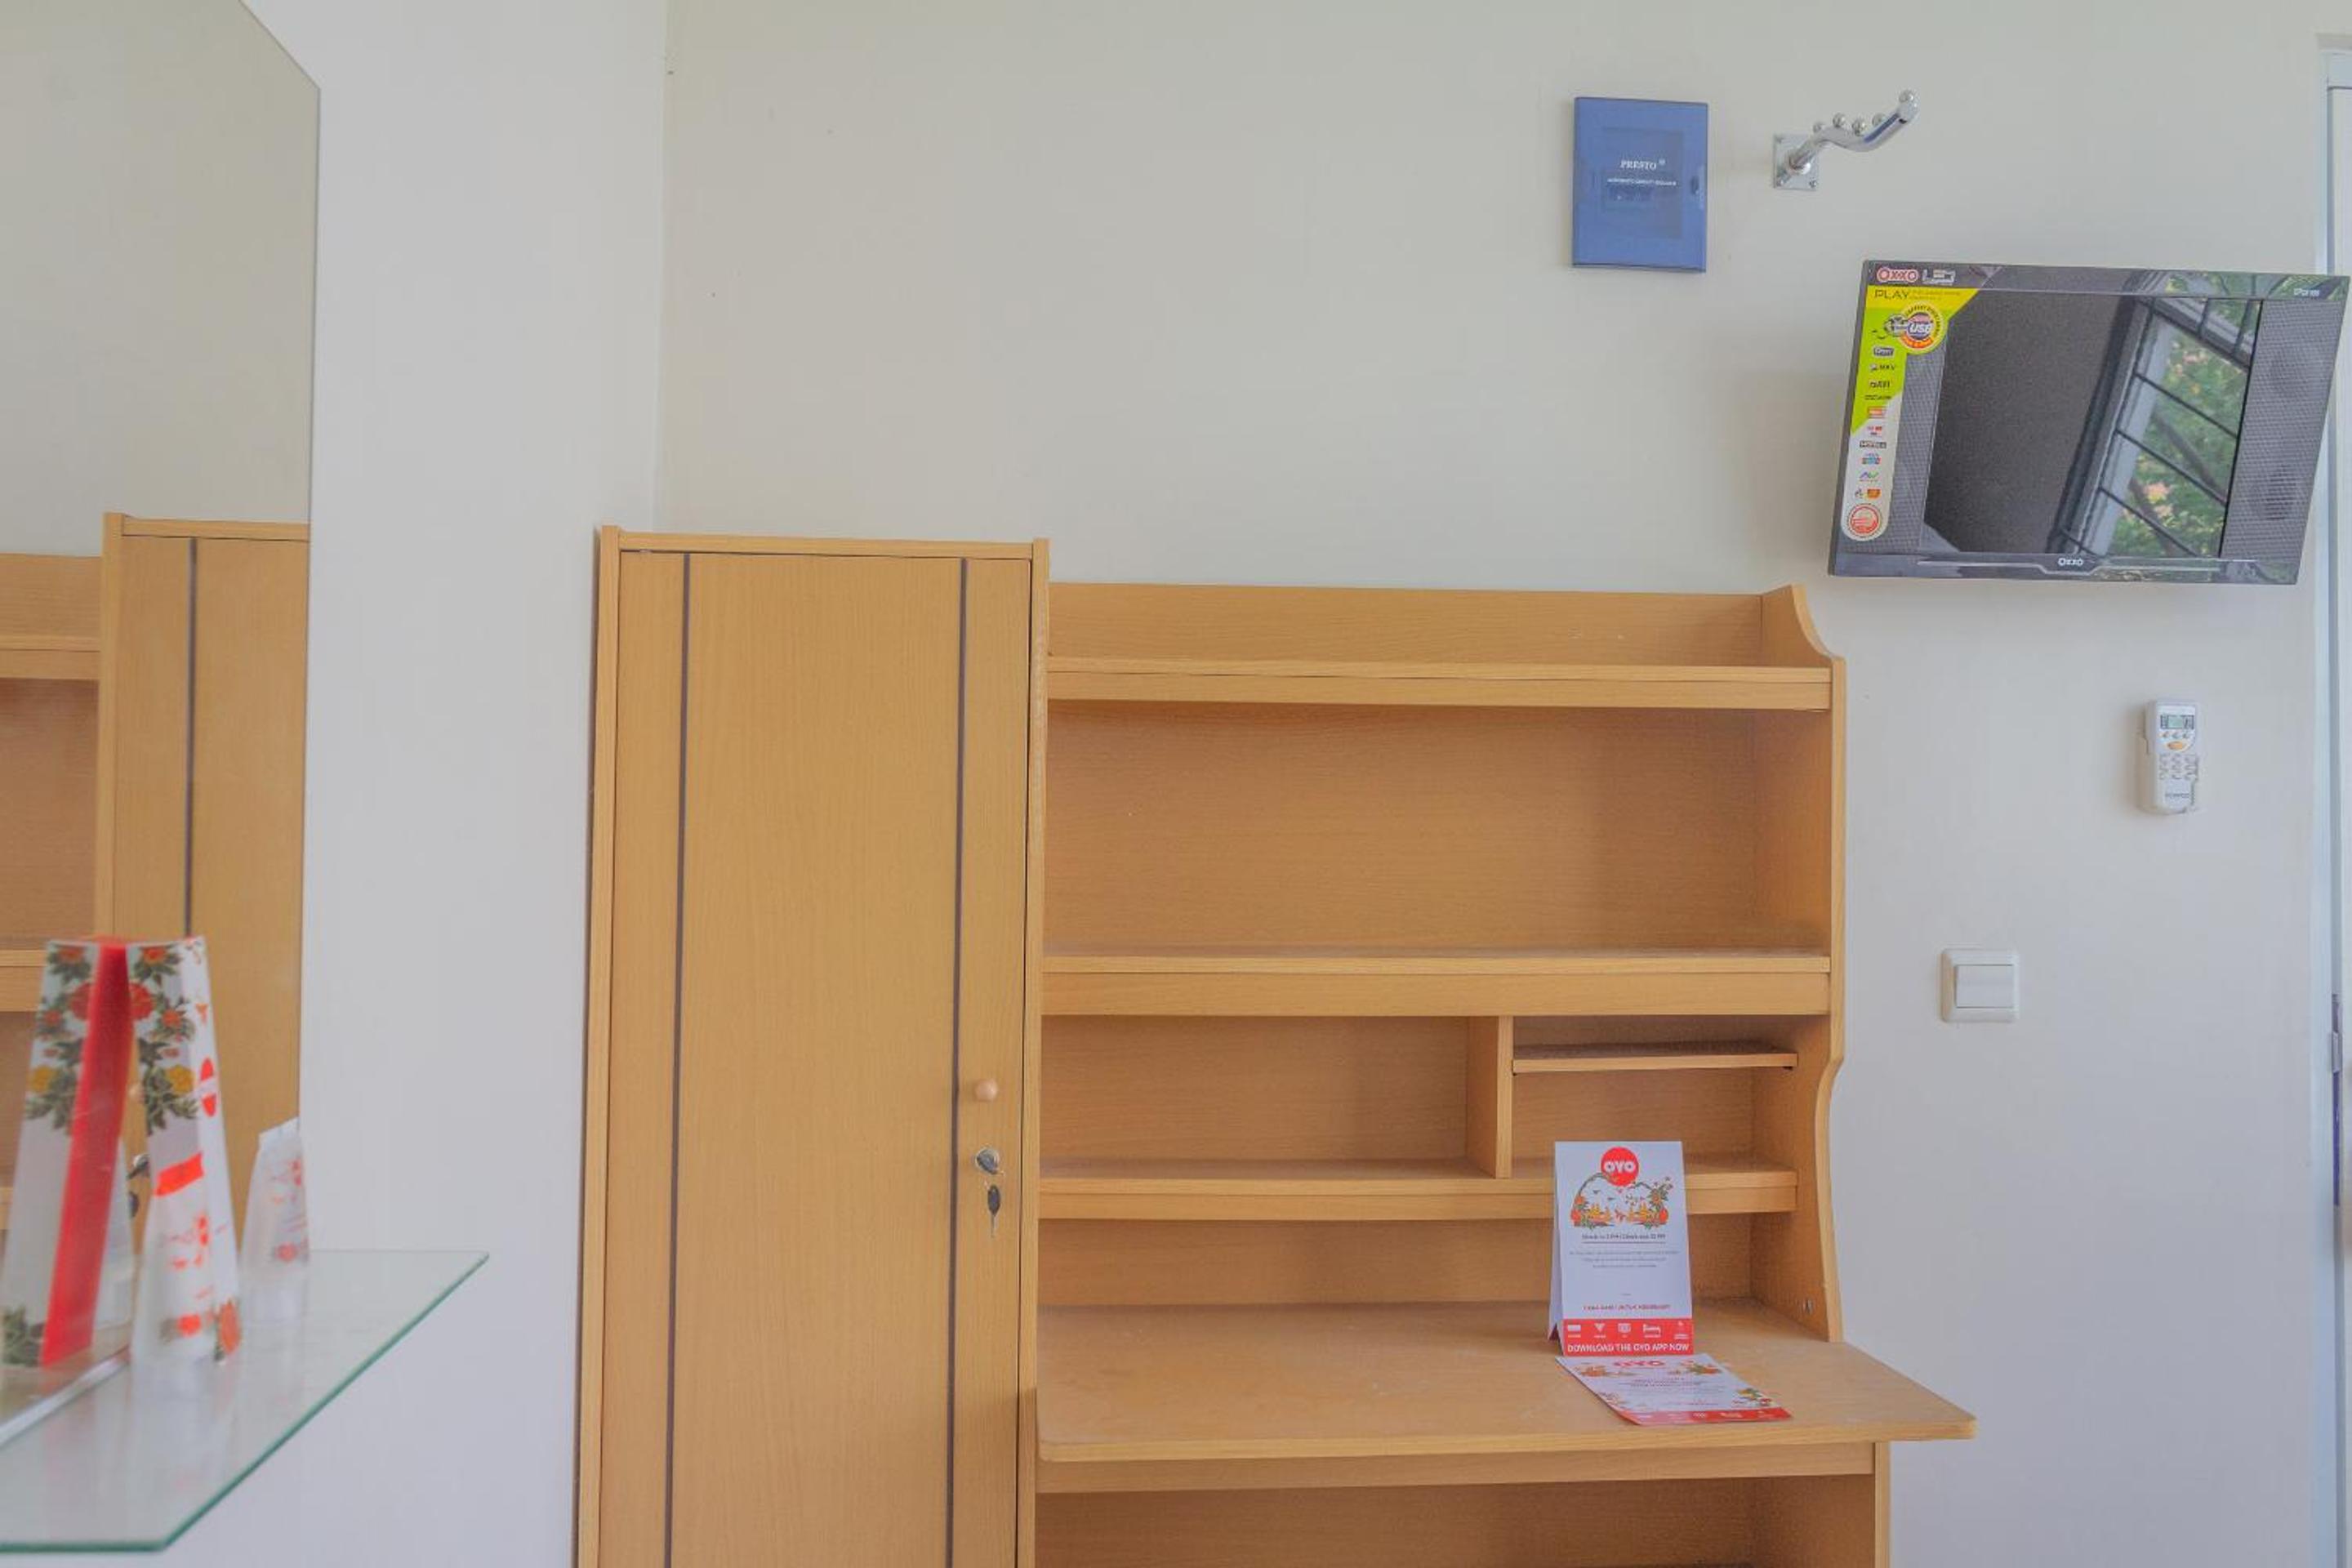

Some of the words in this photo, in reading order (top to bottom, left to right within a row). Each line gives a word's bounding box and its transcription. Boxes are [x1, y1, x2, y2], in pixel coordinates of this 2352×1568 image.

[1619, 159, 1657, 171] PRESTO
[1874, 289, 1909, 300] PLAY
[1604, 1160, 1636, 1174] OYO
[1567, 1343, 1614, 1352] DOWNLOAD
[1615, 1343, 1632, 1352] THE
[1651, 1343, 1668, 1352] APP
[1669, 1342, 1689, 1352] NOW
